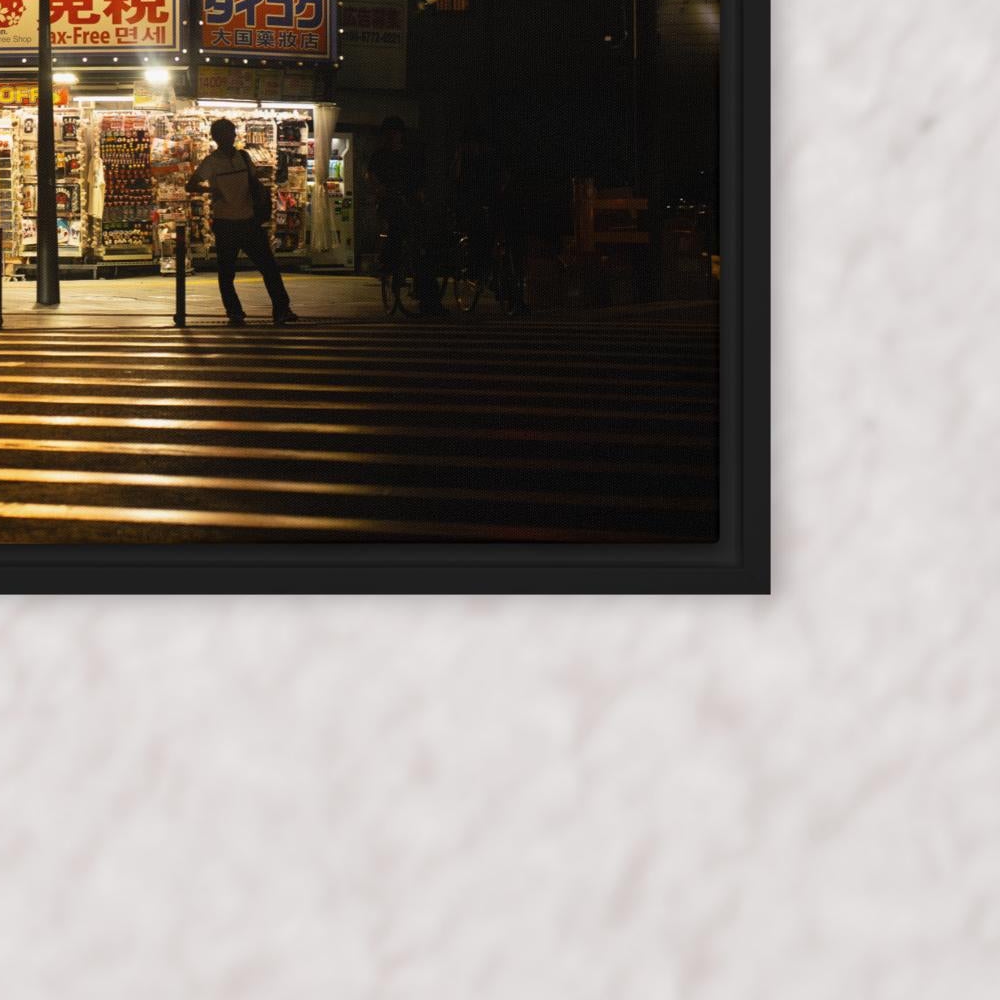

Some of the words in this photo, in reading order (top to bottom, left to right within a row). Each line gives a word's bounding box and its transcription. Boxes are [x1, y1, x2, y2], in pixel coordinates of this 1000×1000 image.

[12, 35, 32, 44] Shop
[37, 26, 110, 46] ax-Free
[115, 27, 167, 45] 면세
